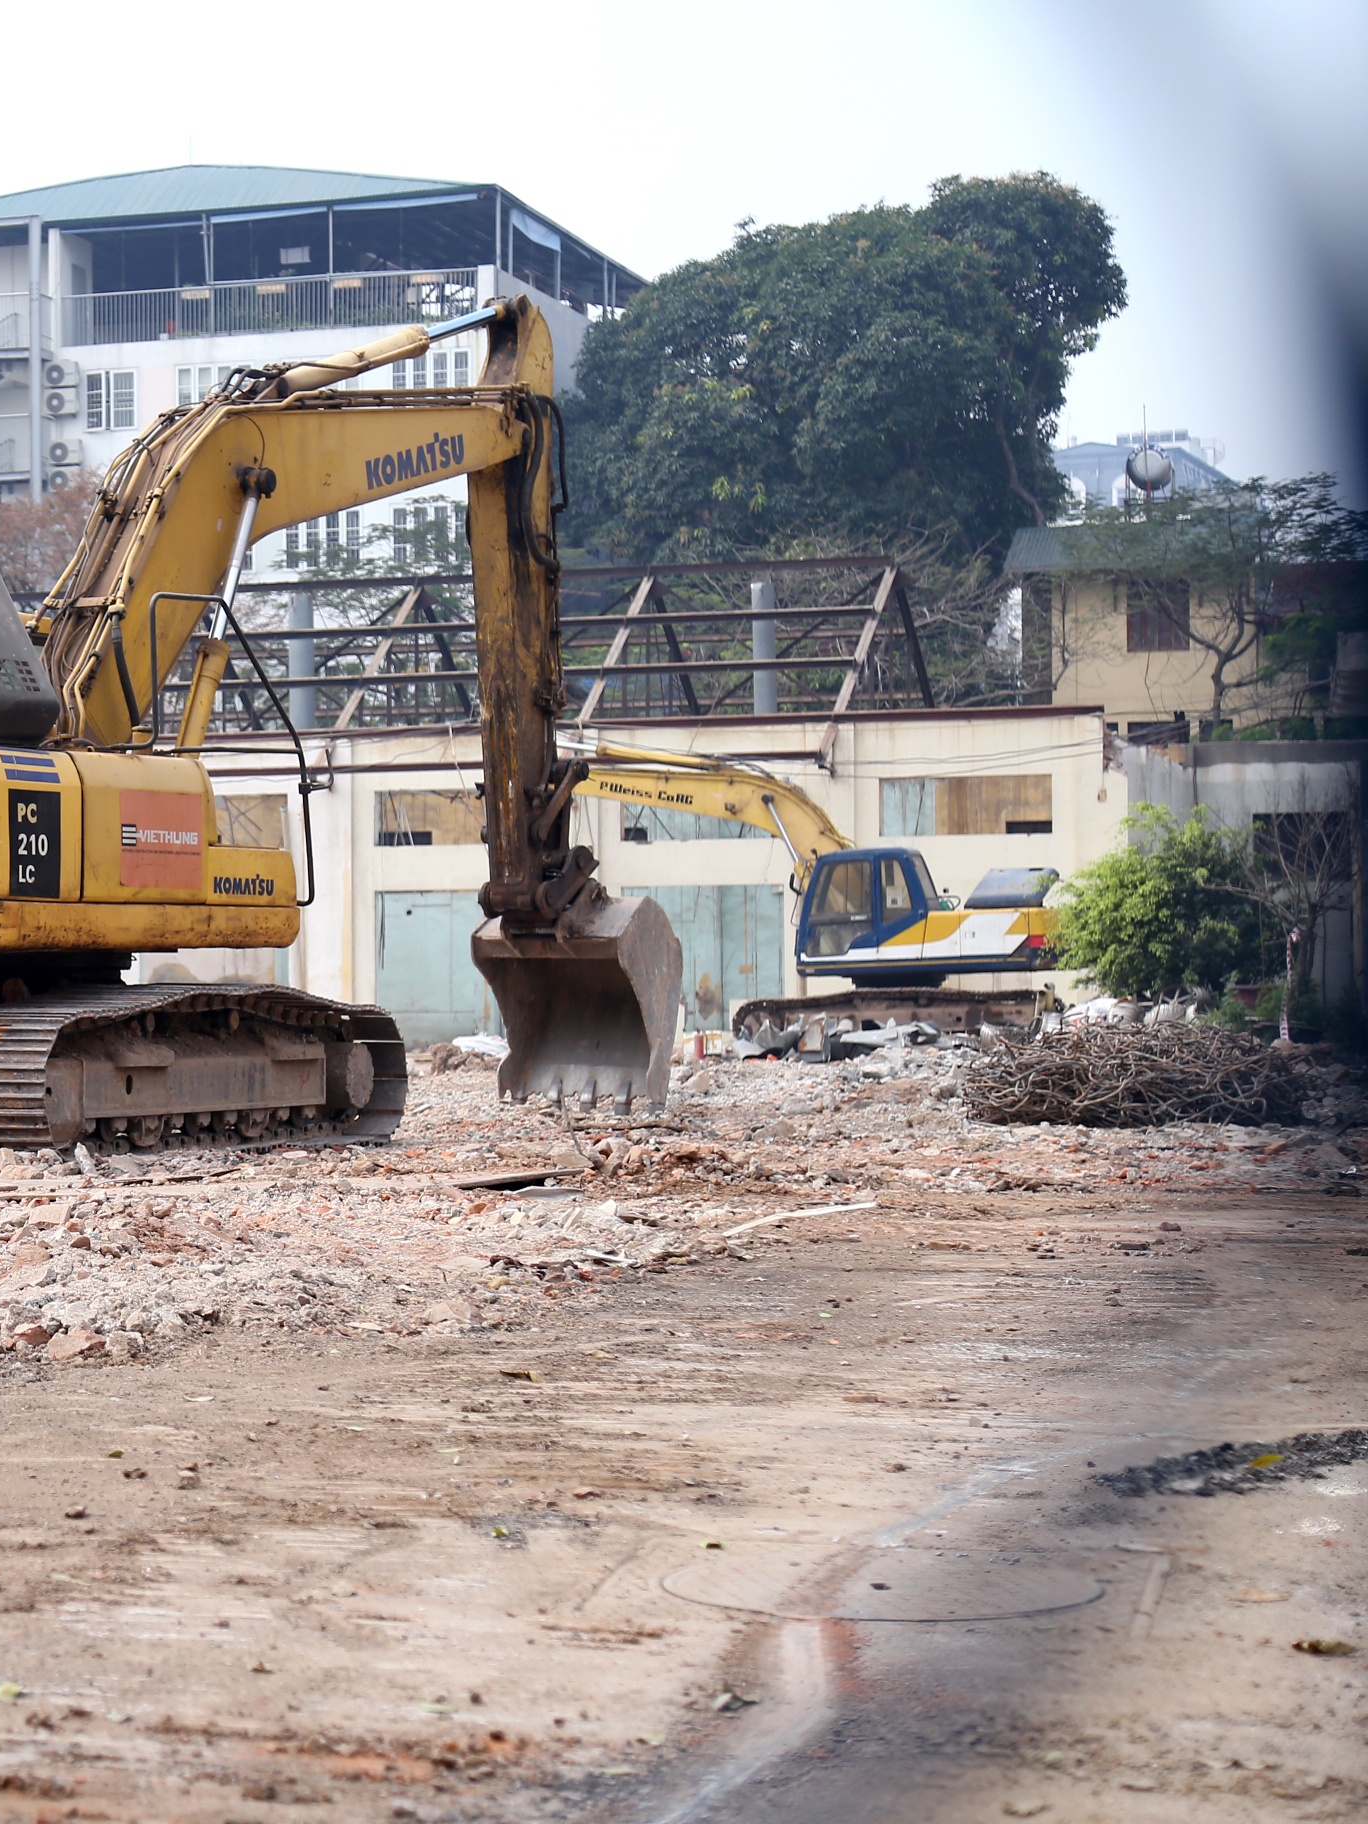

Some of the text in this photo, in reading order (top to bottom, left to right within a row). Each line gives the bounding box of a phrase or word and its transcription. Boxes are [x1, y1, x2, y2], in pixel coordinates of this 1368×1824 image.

[365, 432, 465, 490] KOMATSU
[17, 802, 38, 824] PC
[17, 833, 49, 856] 210
[138, 829, 199, 845] VIETHUNG
[18, 864, 36, 884] LC
[213, 874, 275, 897] KOMATSU
